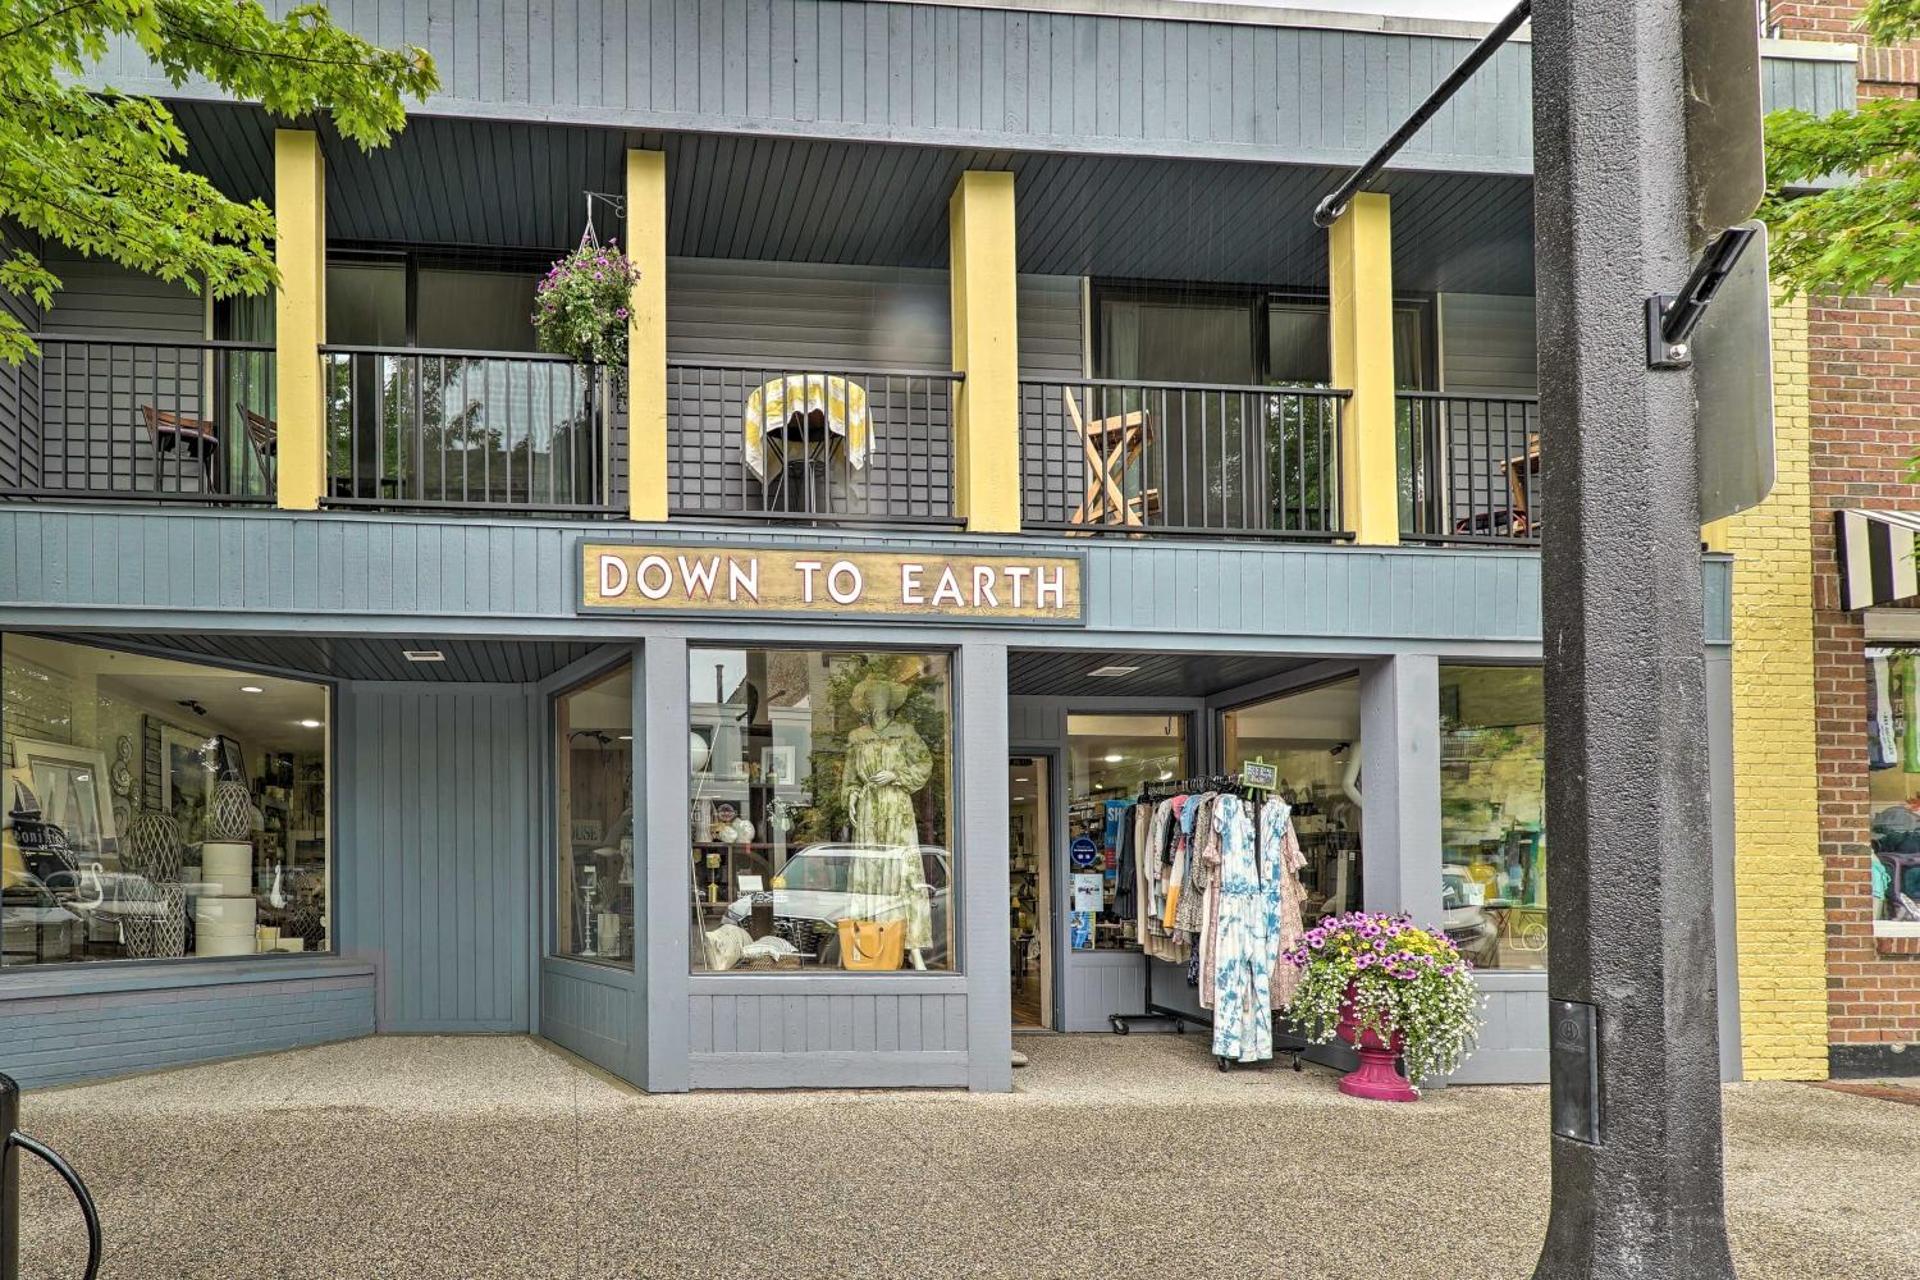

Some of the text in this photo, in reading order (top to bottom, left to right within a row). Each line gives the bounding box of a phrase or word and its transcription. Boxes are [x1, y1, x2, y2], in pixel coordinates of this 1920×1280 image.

[599, 554, 1066, 610] DOWN TO EARTH
